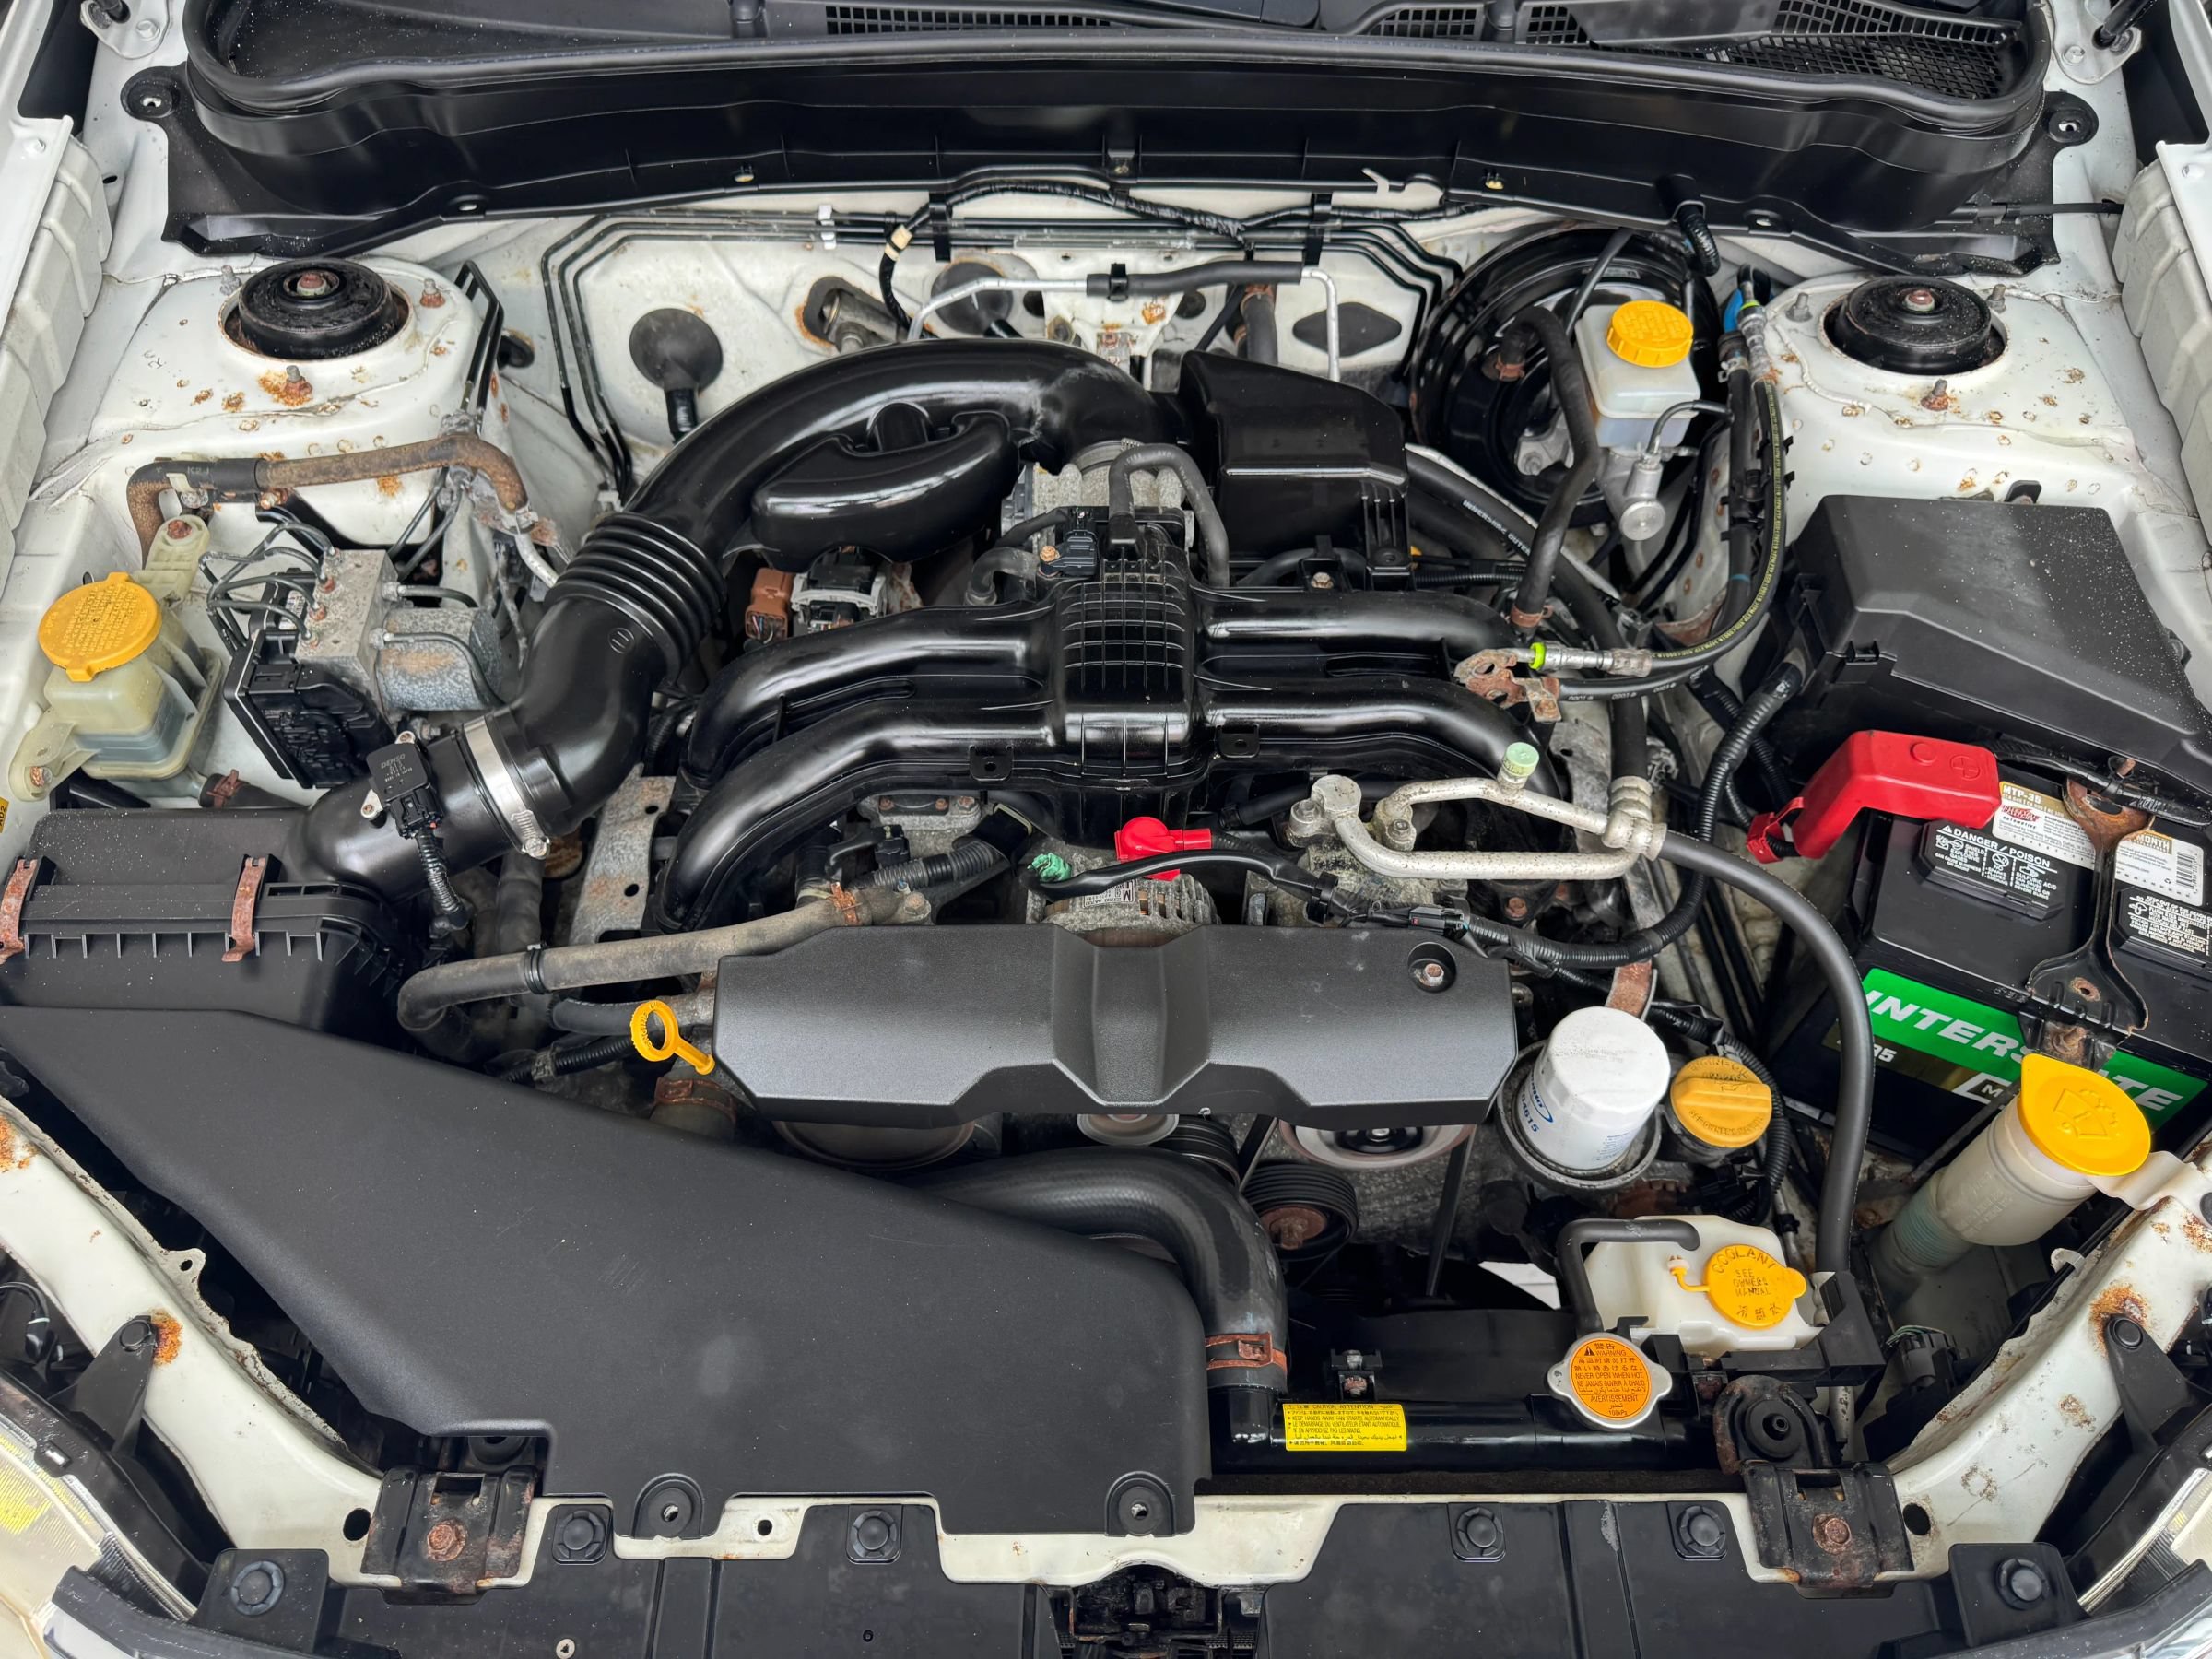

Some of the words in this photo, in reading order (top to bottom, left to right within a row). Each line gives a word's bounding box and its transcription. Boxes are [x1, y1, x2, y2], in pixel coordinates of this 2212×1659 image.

[1952, 828, 1999, 851] DANGER
[2009, 847, 2051, 867] POISON
[2136, 834, 2170, 851] MONTH
[1712, 1247, 1777, 1274] COOLANT
[1735, 1269, 1755, 1277] SEE
[1590, 1394, 1639, 1403] AVERTISSEMENT
